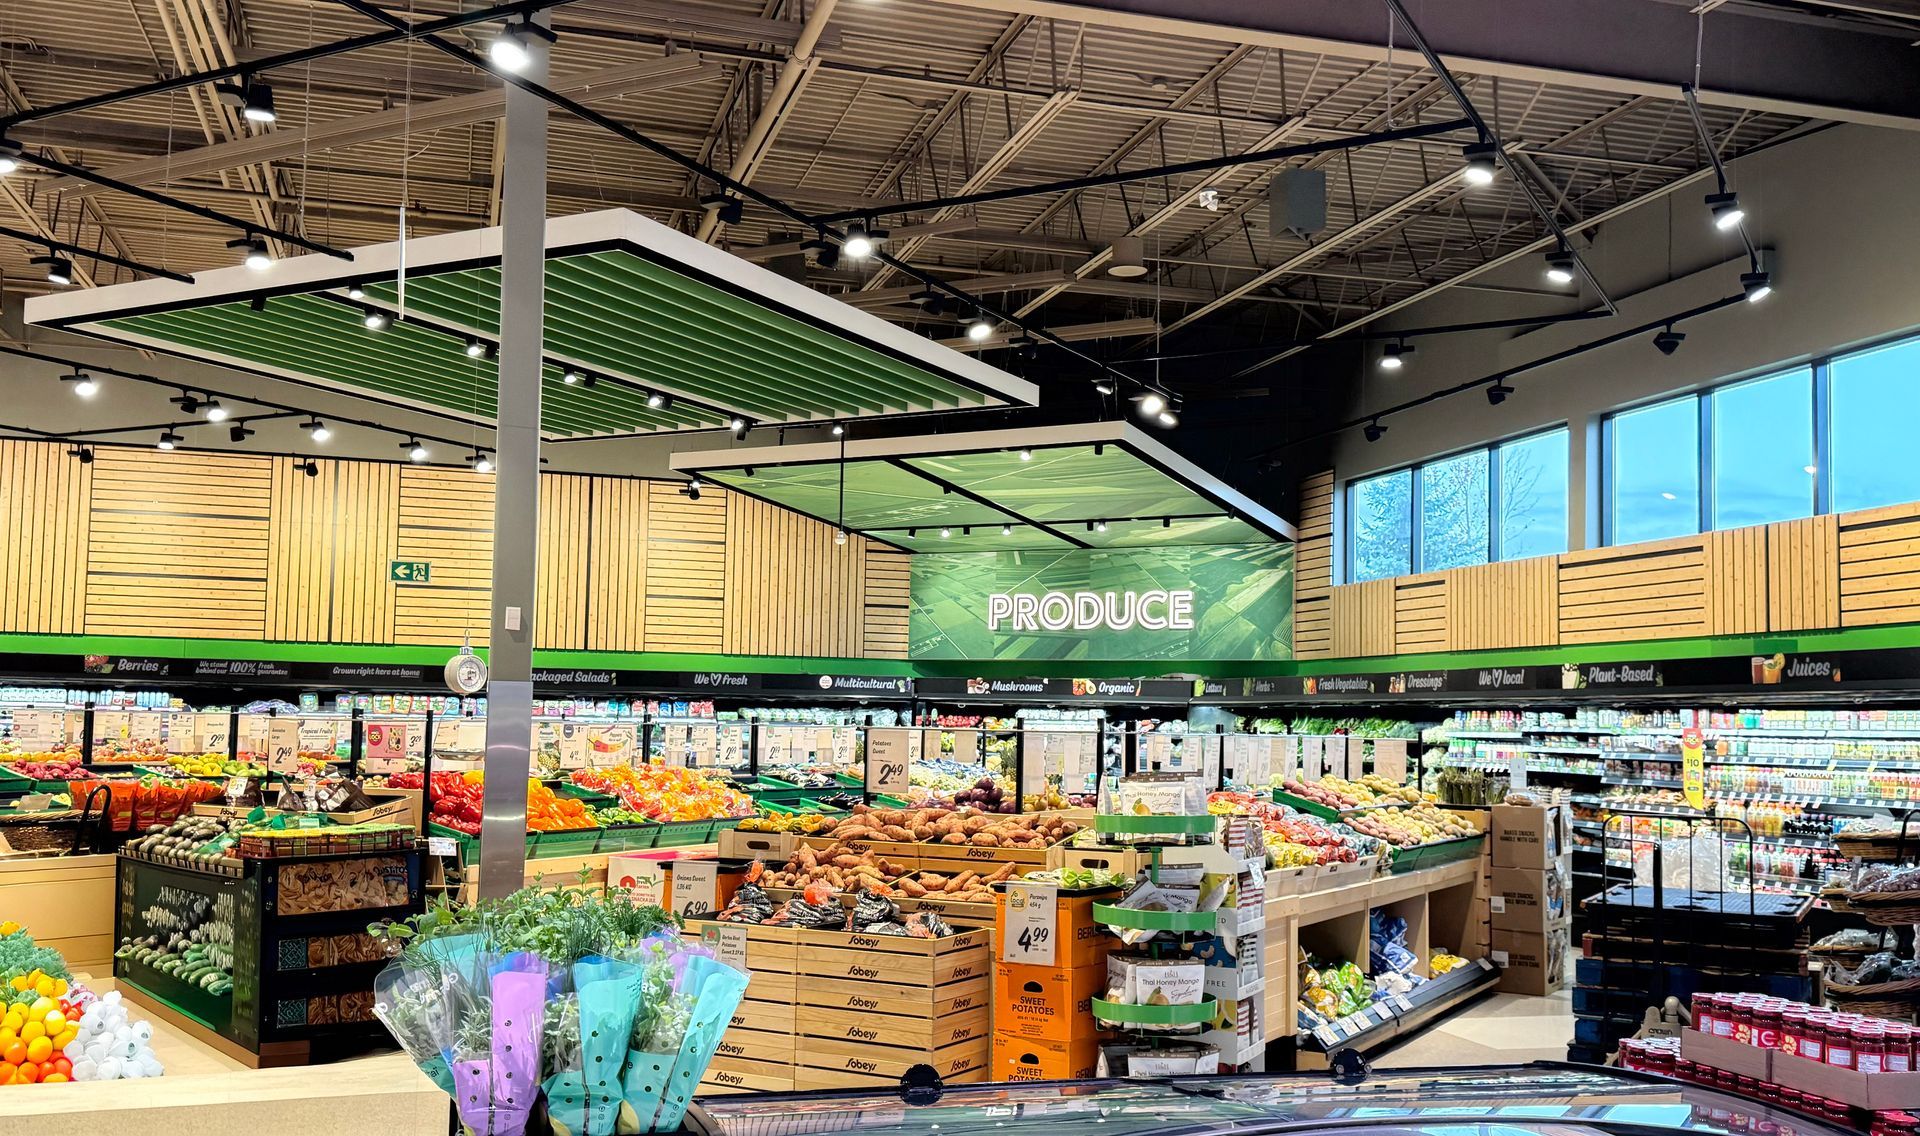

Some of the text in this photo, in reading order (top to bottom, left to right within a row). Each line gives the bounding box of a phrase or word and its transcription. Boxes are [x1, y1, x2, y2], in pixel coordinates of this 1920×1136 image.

[988, 591, 1194, 631] PRODUCE
[117, 658, 159, 672] Berries
[195, 666, 216, 674] behind
[229, 662, 256, 673] 100%
[333, 666, 356, 675] Grown
[356, 667, 374, 676] right
[375, 667, 391, 675] here
[401, 668, 420, 676] home
[1787, 657, 1831, 678] Juices
[531, 670, 610, 684] ackaged Salads
[694, 673, 748, 685] We fresh
[1479, 668, 1525, 685] We local
[1589, 664, 1654, 683] Plant-Based
[834, 677, 896, 690] Multicultural
[991, 680, 1044, 692] Mushrooms
[1098, 681, 1135, 694] Organic
[1318, 677, 1368, 694] Fresh Vegetables
[1407, 674, 1443, 691] Dressings
[966, 848, 996, 859] Sobeys
[916, 901, 945, 913] Sobeys
[848, 935, 880, 948] Sobeys
[952, 935, 973, 948] Sobeys
[847, 965, 879, 978] Sobeys
[952, 965, 972, 979] Sobeys
[1178, 978, 1200, 986] Mango
[847, 996, 879, 1009] Sobeys
[951, 996, 972, 1010] Sobeys
[1020, 996, 1047, 1007] SWEET
[1012, 1003, 1055, 1016] POTATOES
[846, 1026, 878, 1040] Sobeys
[951, 1027, 971, 1041] Sobeys
[716, 1040, 745, 1054] Sobeys
[845, 1057, 877, 1071] Sobeys
[950, 1058, 971, 1073] Sobeys
[715, 1071, 743, 1085] Sobeys
[1016, 1067, 1043, 1076] SWEET
